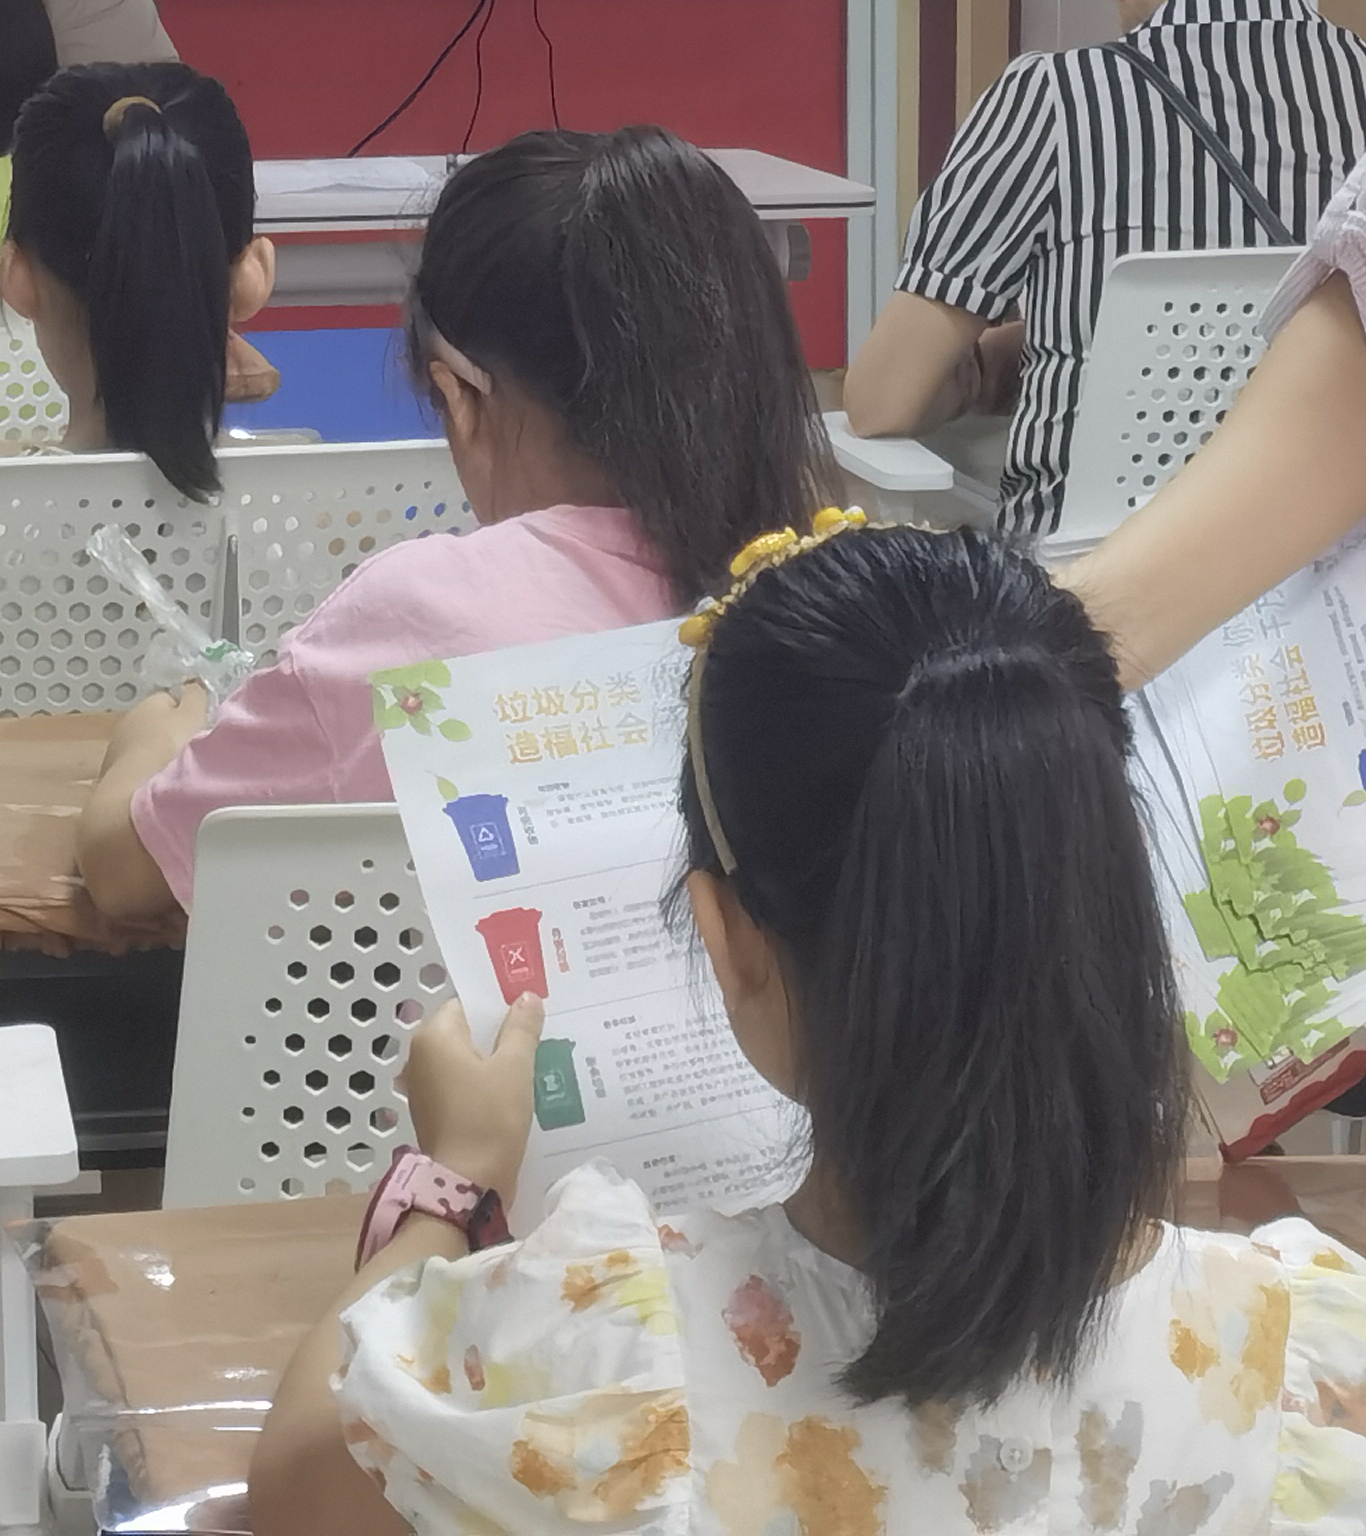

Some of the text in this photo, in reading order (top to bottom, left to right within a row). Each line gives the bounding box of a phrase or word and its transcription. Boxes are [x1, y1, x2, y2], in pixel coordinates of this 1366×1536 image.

[492, 670, 642, 724] 垃圾分类
[1269, 644, 1327, 753] 造福社会
[504, 711, 649, 765] 造福社会
